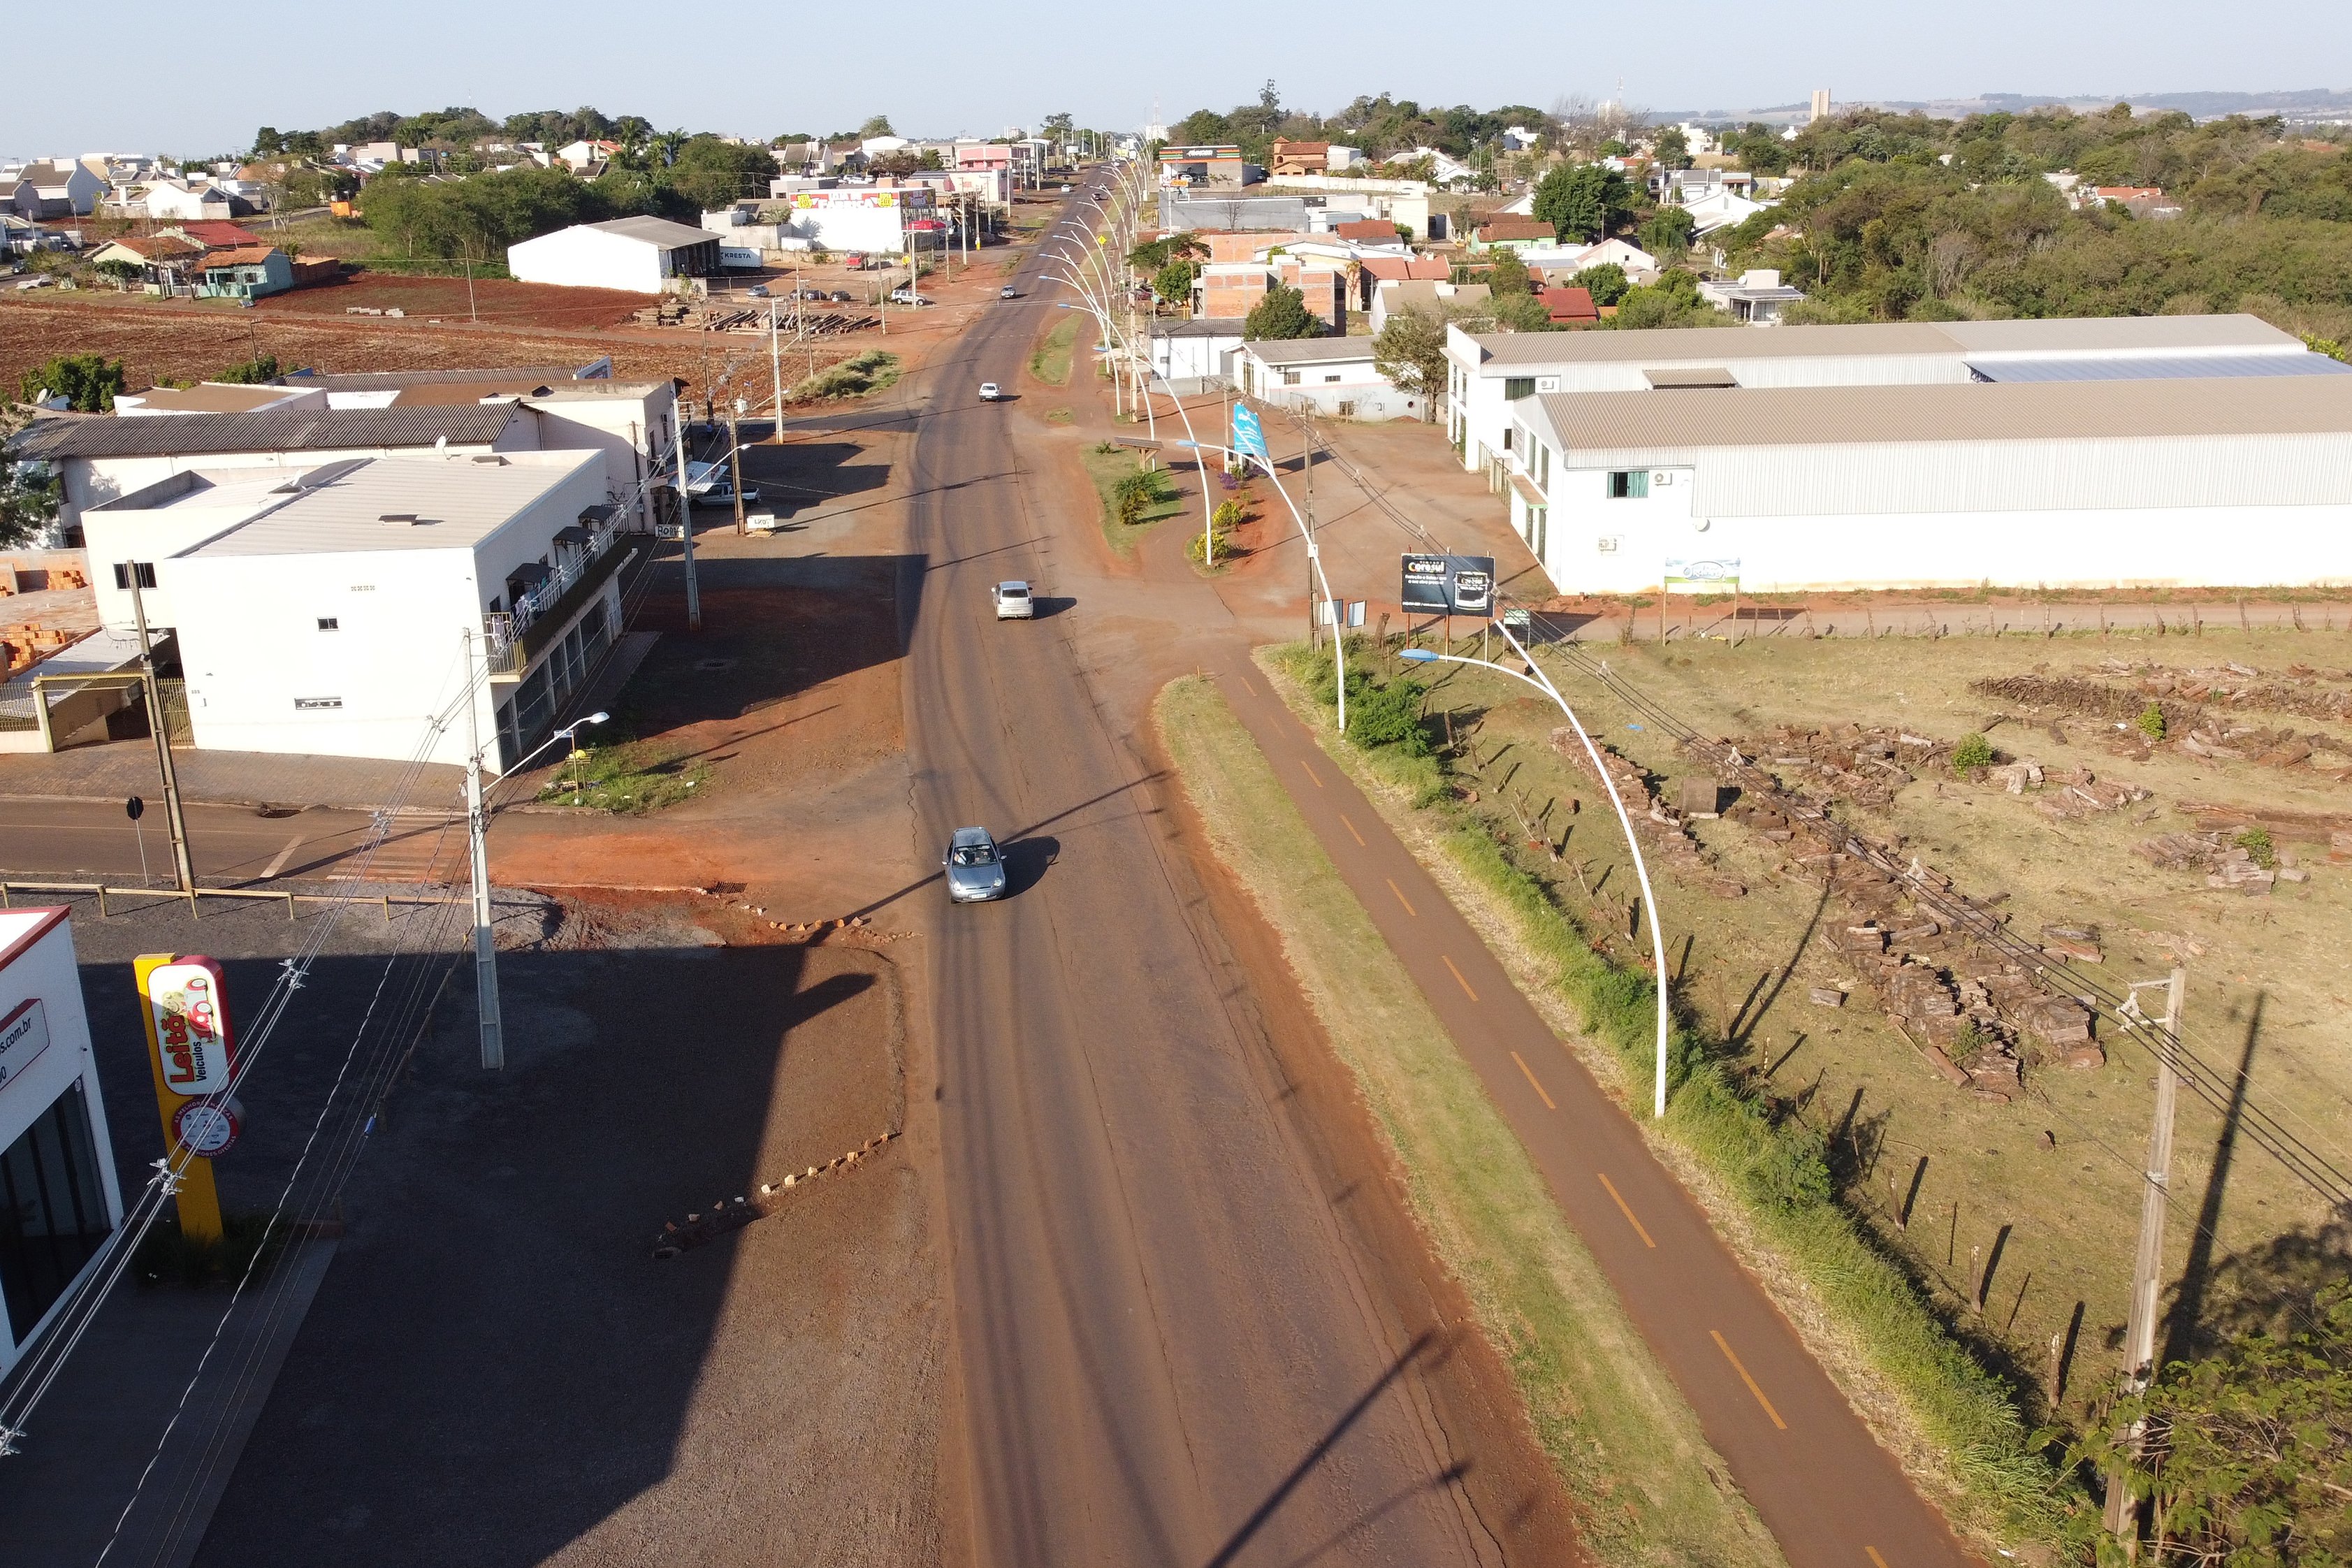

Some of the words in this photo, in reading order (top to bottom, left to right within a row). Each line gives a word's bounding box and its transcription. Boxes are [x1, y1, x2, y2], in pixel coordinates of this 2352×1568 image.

[0, 1017, 31, 1056] s.com.br
[193, 1041, 208, 1082] Veículos
[210, 1101, 233, 1121] MACAS
